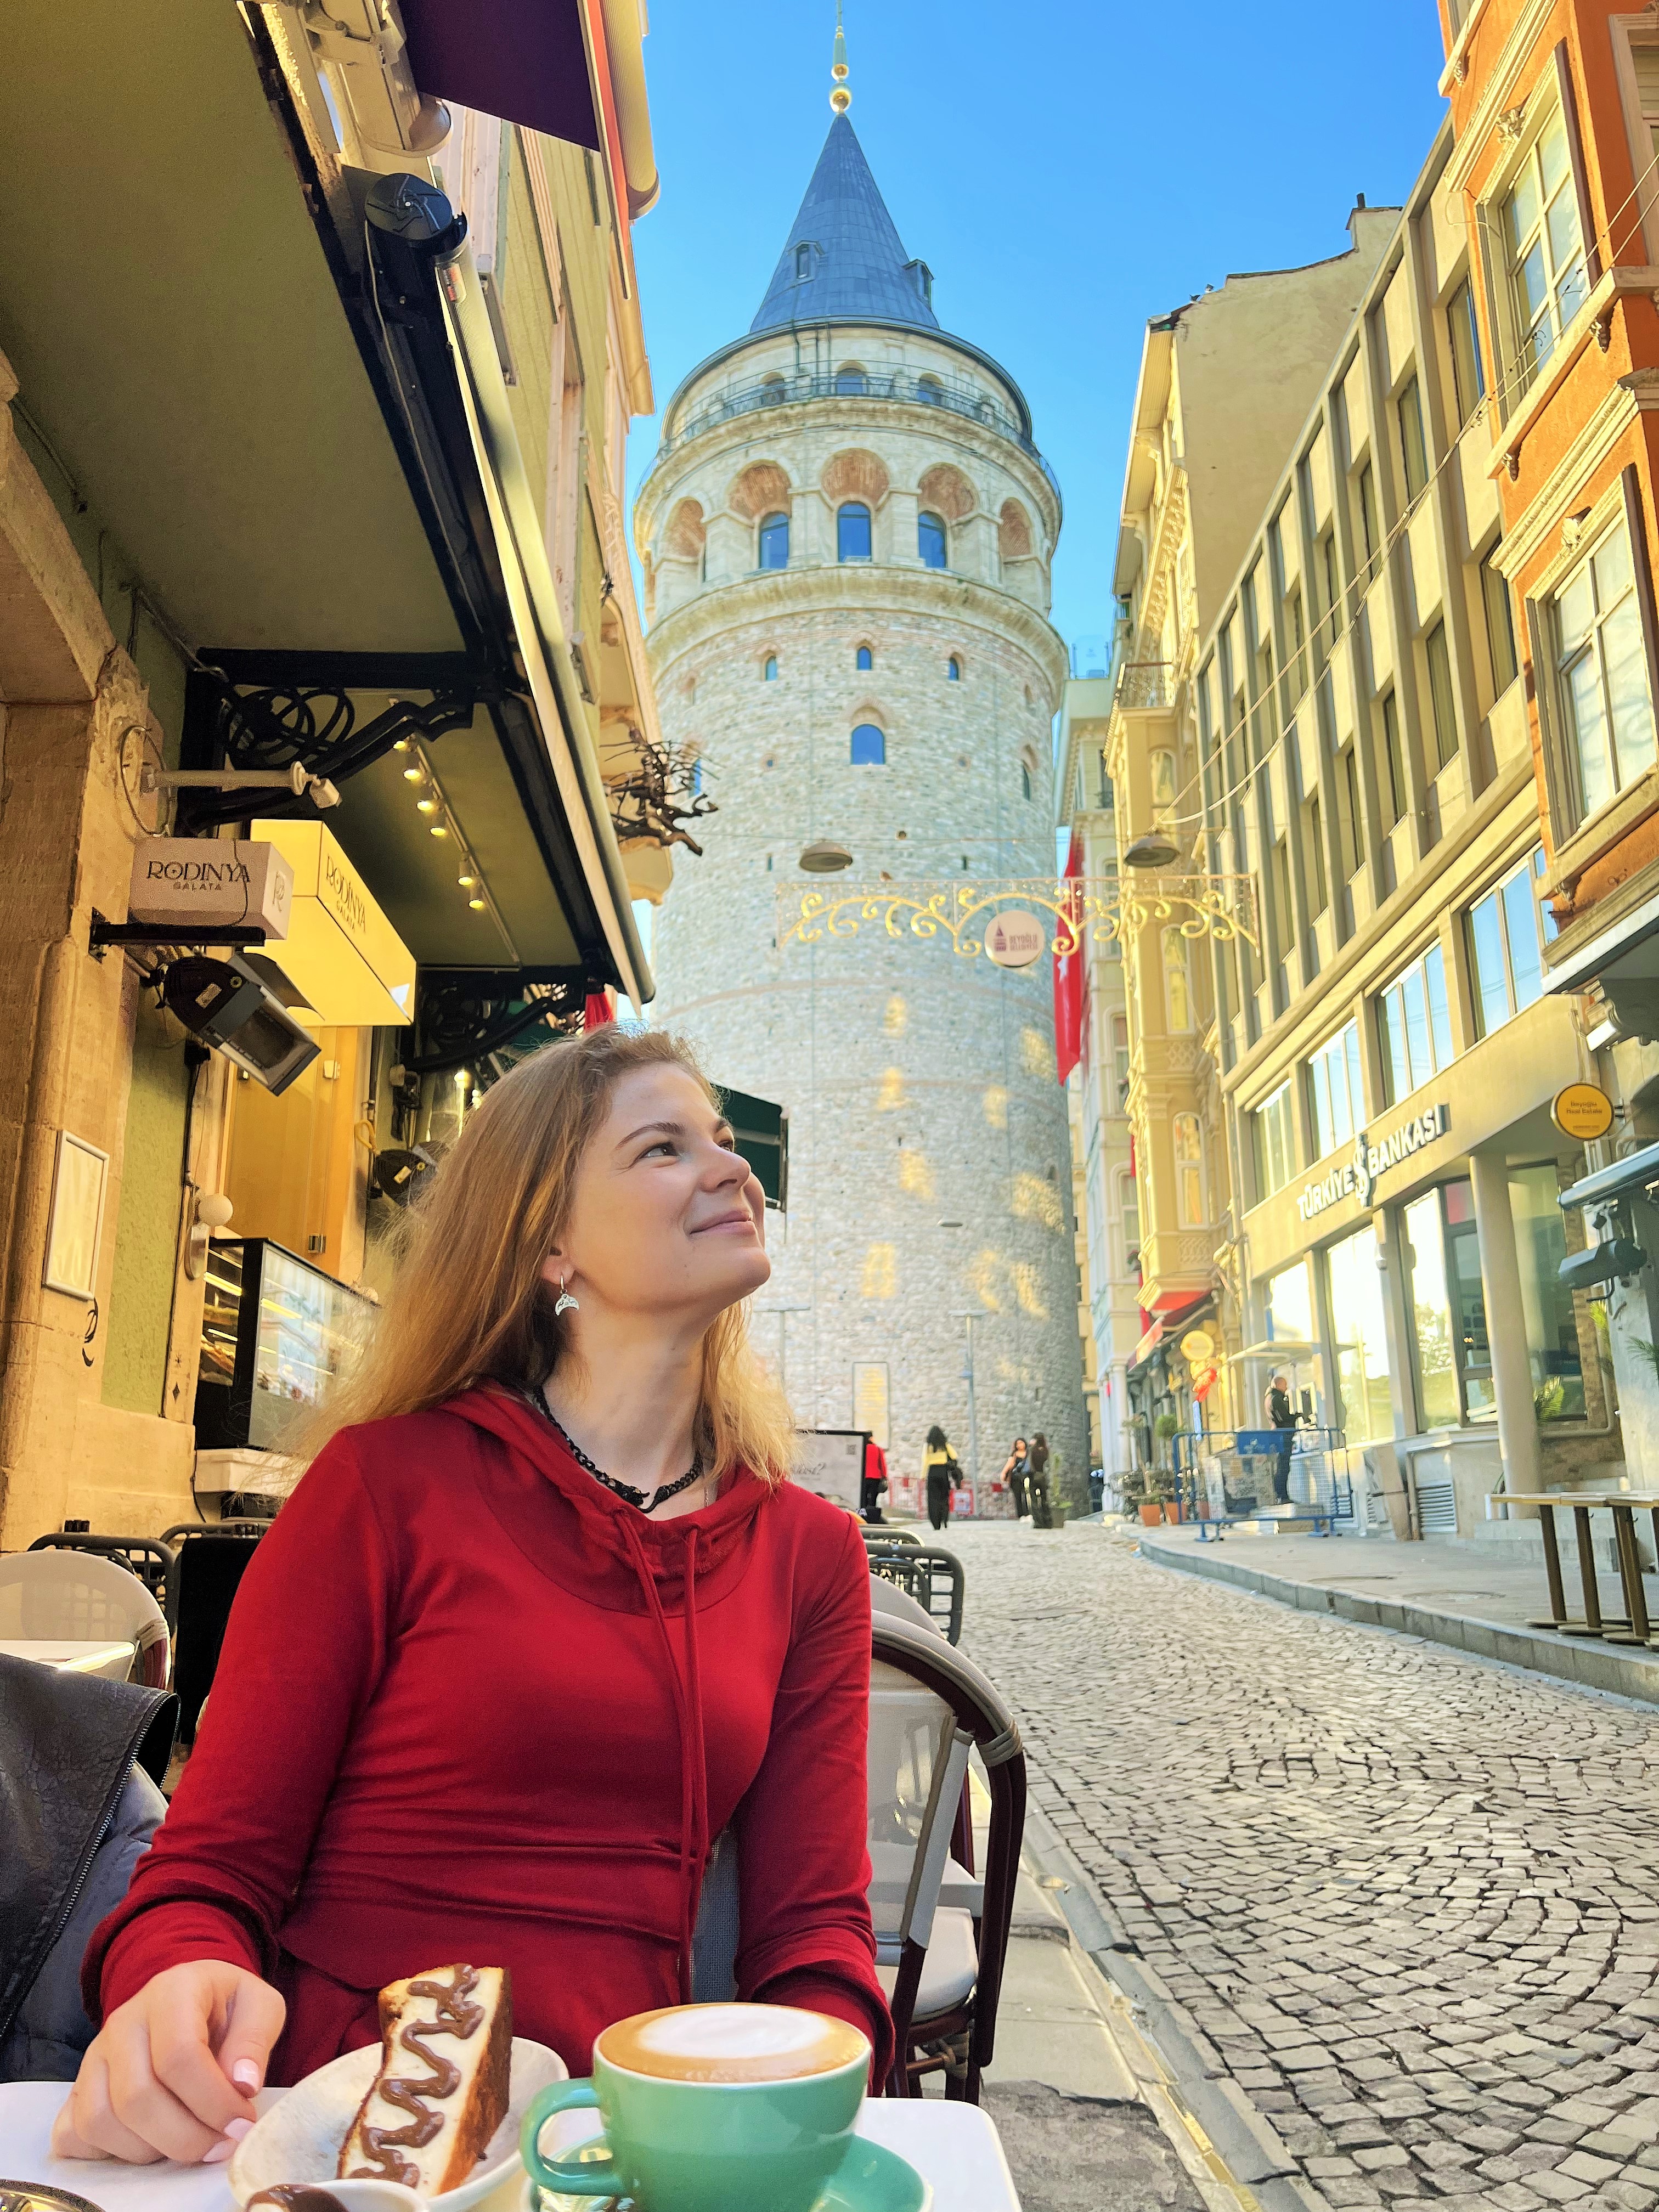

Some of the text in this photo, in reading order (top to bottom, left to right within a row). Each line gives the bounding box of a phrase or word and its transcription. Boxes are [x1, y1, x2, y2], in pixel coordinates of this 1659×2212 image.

[147, 860, 250, 882] RODINYA
[173, 882, 222, 891] GALATA
[326, 853, 366, 935] RODINYA
[1296, 1163, 1356, 1222] TÜRKİYE
[1367, 1102, 1451, 1179] BANKASI
